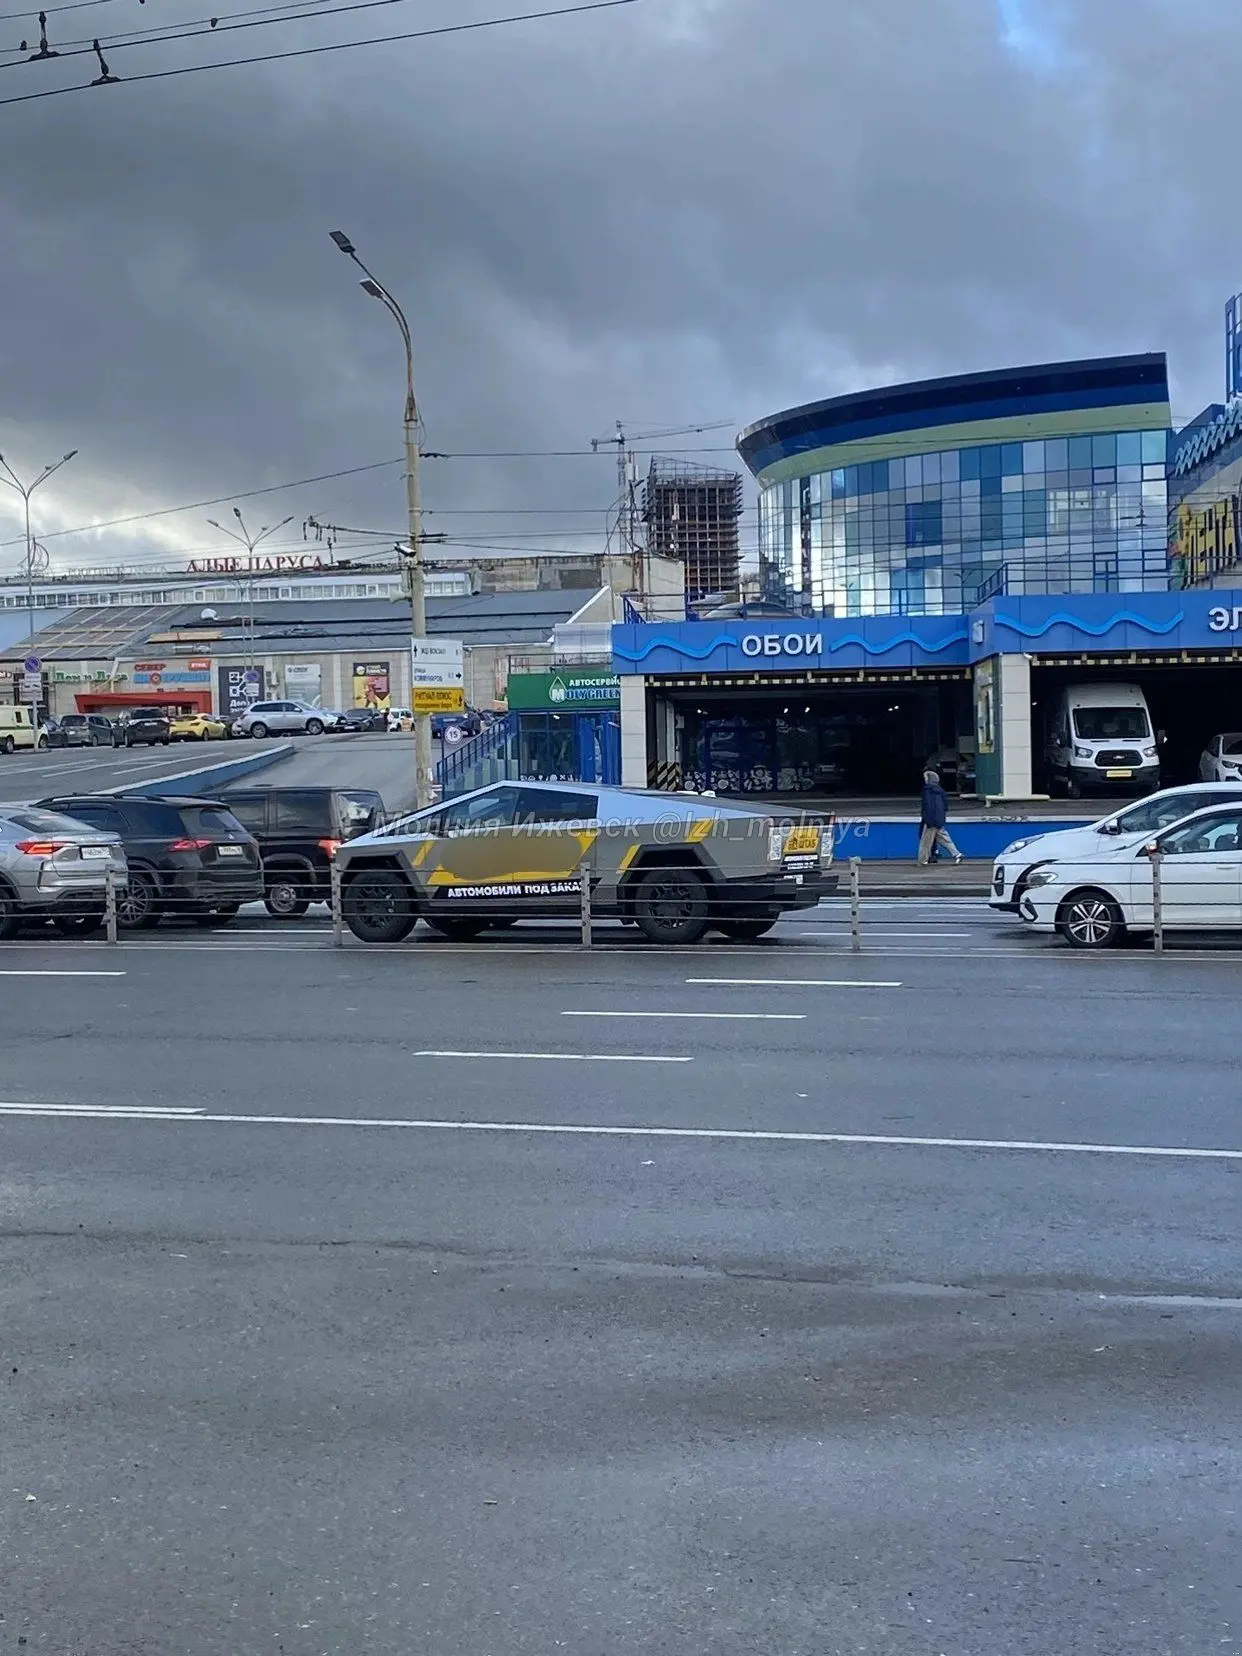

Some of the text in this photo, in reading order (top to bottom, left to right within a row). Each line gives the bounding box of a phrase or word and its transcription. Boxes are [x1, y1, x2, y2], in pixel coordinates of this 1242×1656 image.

[187, 557, 243, 573] АЛЫЕ
[247, 555, 323, 572] ПАРУСА
[742, 633, 822, 656] ОБОИ
[449, 731, 458, 739] 15
[447, 881, 582, 898] АВТОМОБИЛИ ПОД ЗАКА
